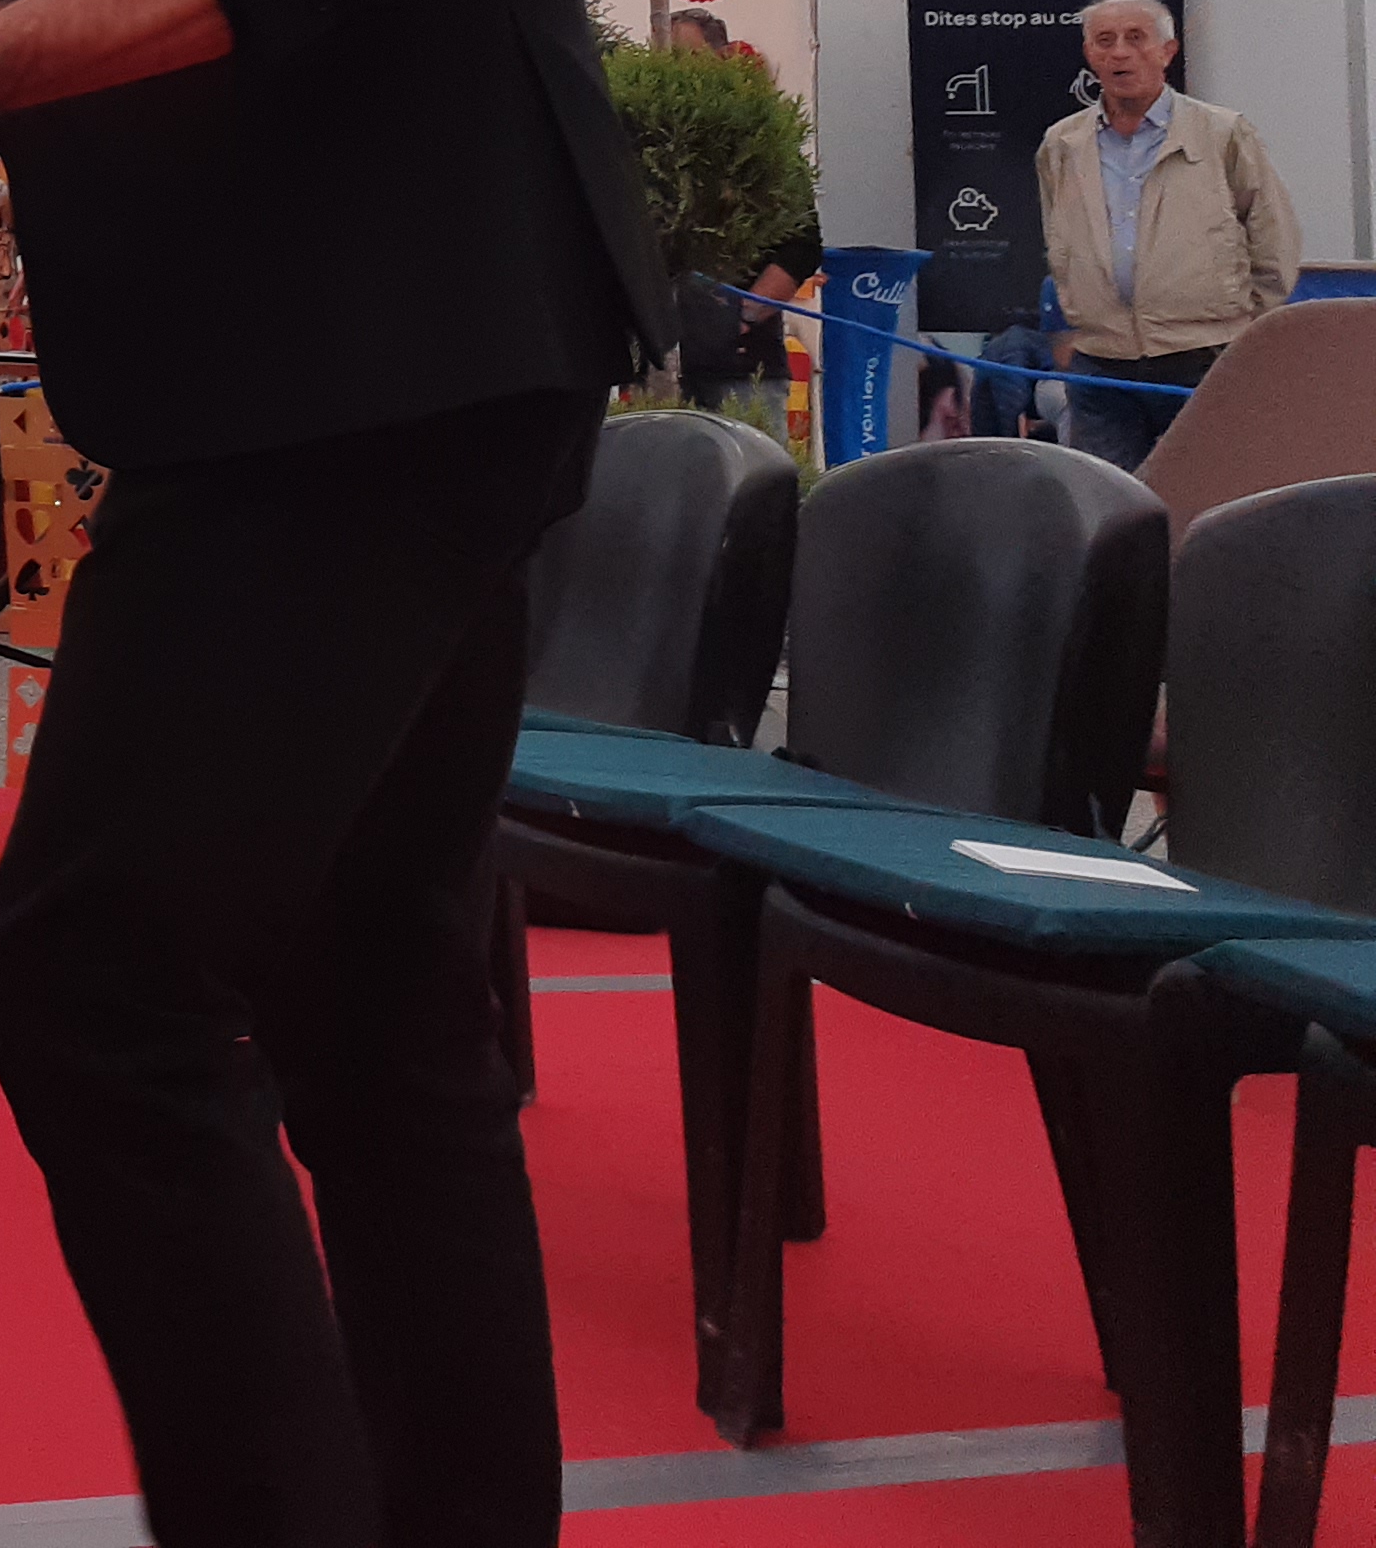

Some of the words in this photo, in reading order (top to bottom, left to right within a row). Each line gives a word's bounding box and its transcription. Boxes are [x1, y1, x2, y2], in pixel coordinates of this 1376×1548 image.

[924, 11, 977, 27] Dites
[980, 11, 1028, 29] stop
[1030, 13, 1055, 25] au
[1059, 13, 1084, 25] ca
[851, 271, 906, 306] Cull
[861, 402, 877, 444] you
